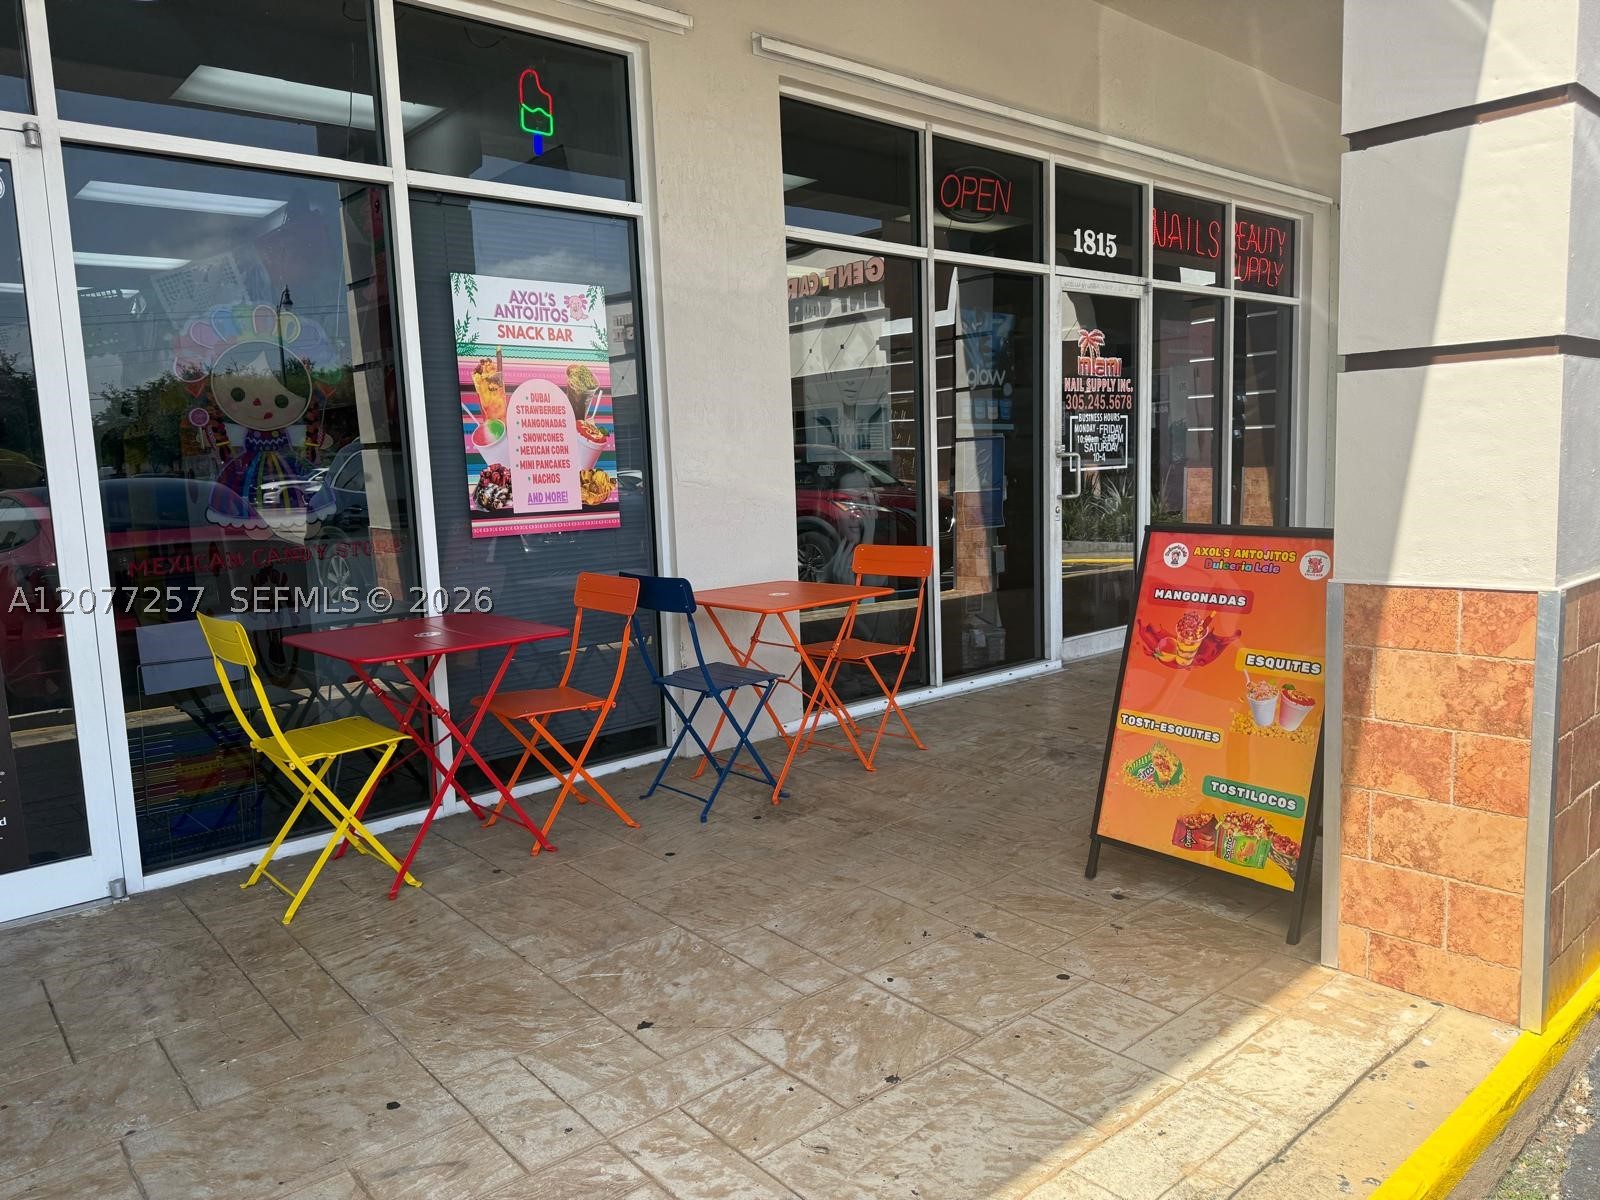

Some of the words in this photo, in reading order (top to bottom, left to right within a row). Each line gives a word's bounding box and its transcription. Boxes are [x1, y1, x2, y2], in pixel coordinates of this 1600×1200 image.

[940, 173, 1013, 214] OPEN
[1152, 207, 1220, 258] NAILS
[1072, 227, 1118, 258] 1815
[508, 288, 557, 307] AXOL'S
[494, 303, 569, 323] ANTOJITOS
[497, 324, 544, 341] SNACK
[547, 327, 574, 343] BAR
[967, 365, 1007, 391] glow
[1064, 377, 1084, 392] NAIL
[1085, 377, 1116, 393] SUPPLY
[1117, 378, 1134, 393] INC.
[530, 393, 550, 403] DUBAI
[1065, 393, 1132, 410] 305.245.5678
[515, 405, 566, 415] STRAWBERRIES
[1078, 412, 1103, 422] BUSINESS
[1103, 412, 1120, 422] HOURS
[521, 418, 567, 429] MANGONADAS
[1074, 423, 1096, 433] MONDAY
[1099, 424, 1123, 434] FRIDAY
[522, 433, 565, 443] SNOWCONES
[520, 445, 550, 456] MEXICAN
[551, 445, 569, 455] CORN
[1084, 442, 1119, 453] SATURDAY
[520, 460, 535, 470] MINI
[535, 459, 571, 470] PANCAKES
[532, 473, 561, 485] NACHOS
[527, 492, 544, 504] AND
[545, 491, 569, 504] MORE!
[128, 550, 244, 578] MEXICAN
[252, 543, 327, 569] CANDY
[1193, 546, 1231, 558] AXOL'S
[1233, 549, 1297, 562] ANTOJITOS
[1254, 562, 1280, 574] Lele
[1154, 588, 1247, 607] MANGONADAS
[1245, 654, 1321, 675] ESQUITES
[1120, 713, 1221, 743] TOSTI-ESQUITES
[1210, 780, 1297, 811] TOSTILOCOS
